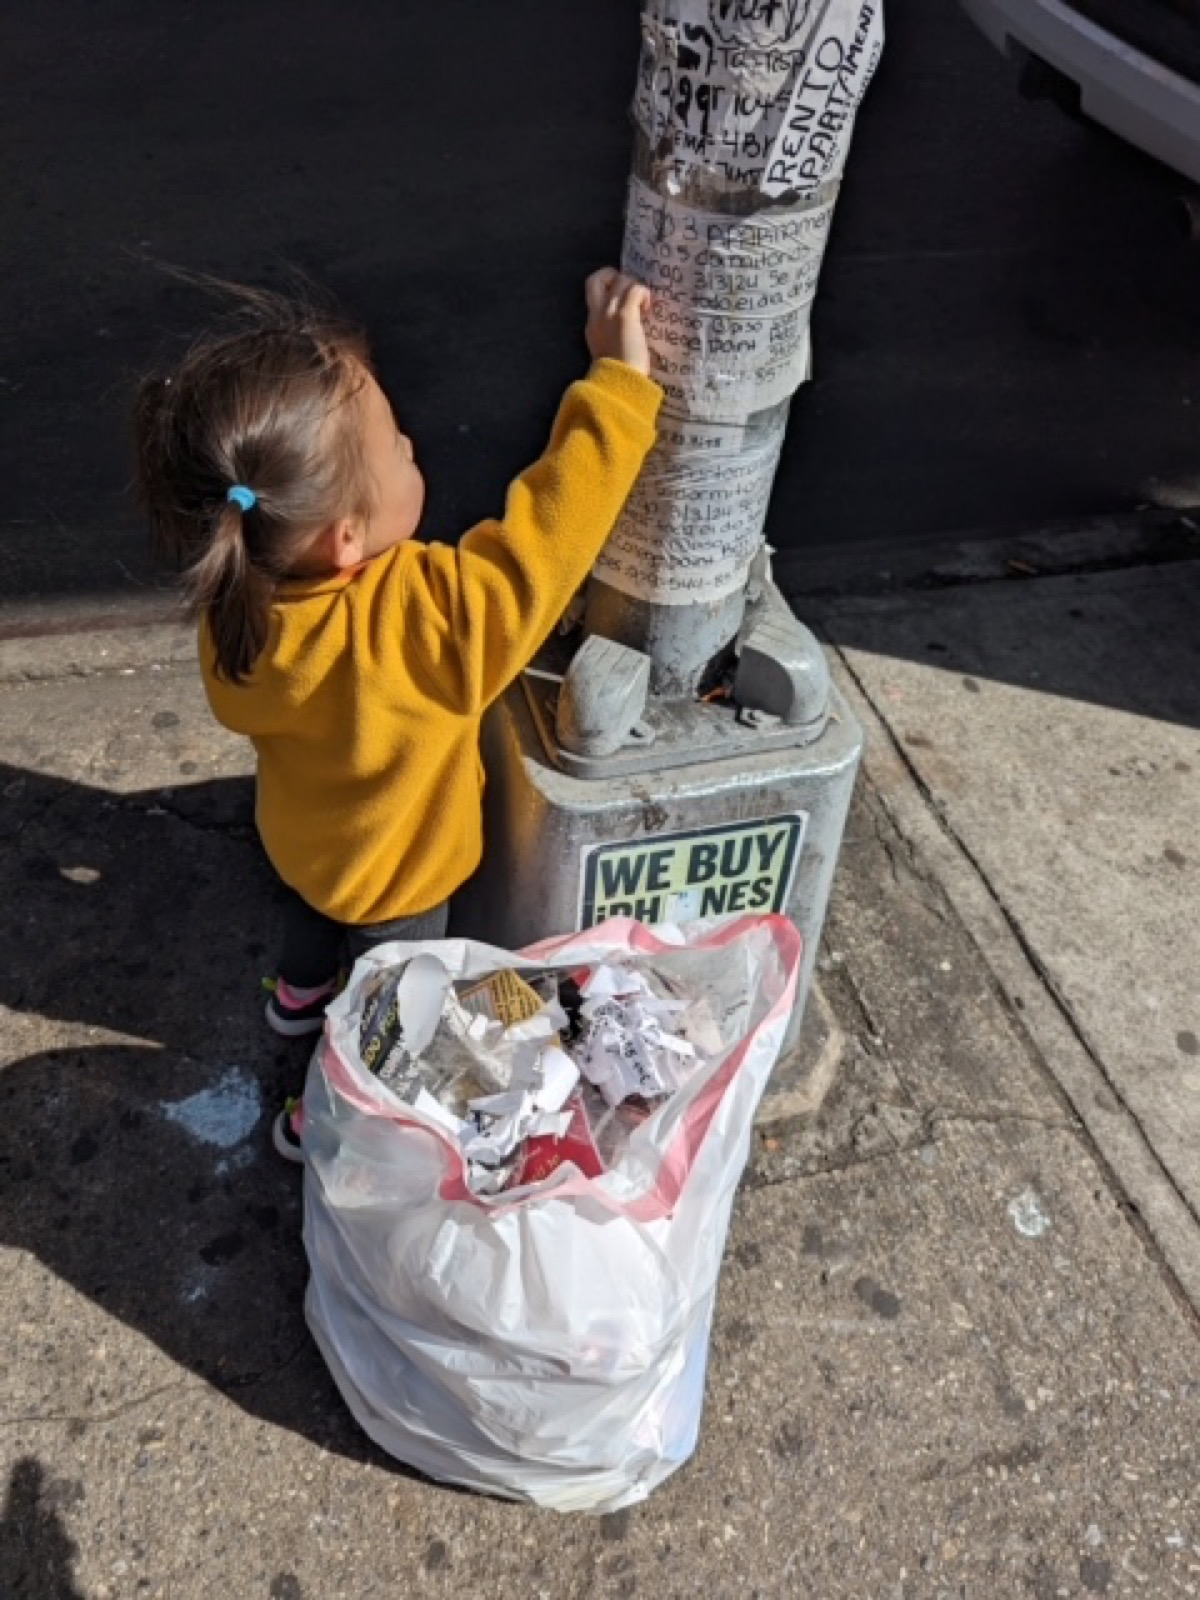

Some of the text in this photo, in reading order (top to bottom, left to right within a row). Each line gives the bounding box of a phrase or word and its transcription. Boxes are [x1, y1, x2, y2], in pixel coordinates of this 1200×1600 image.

[600, 829, 787, 900] WE BUY
[597, 876, 774, 926] iPHNES
